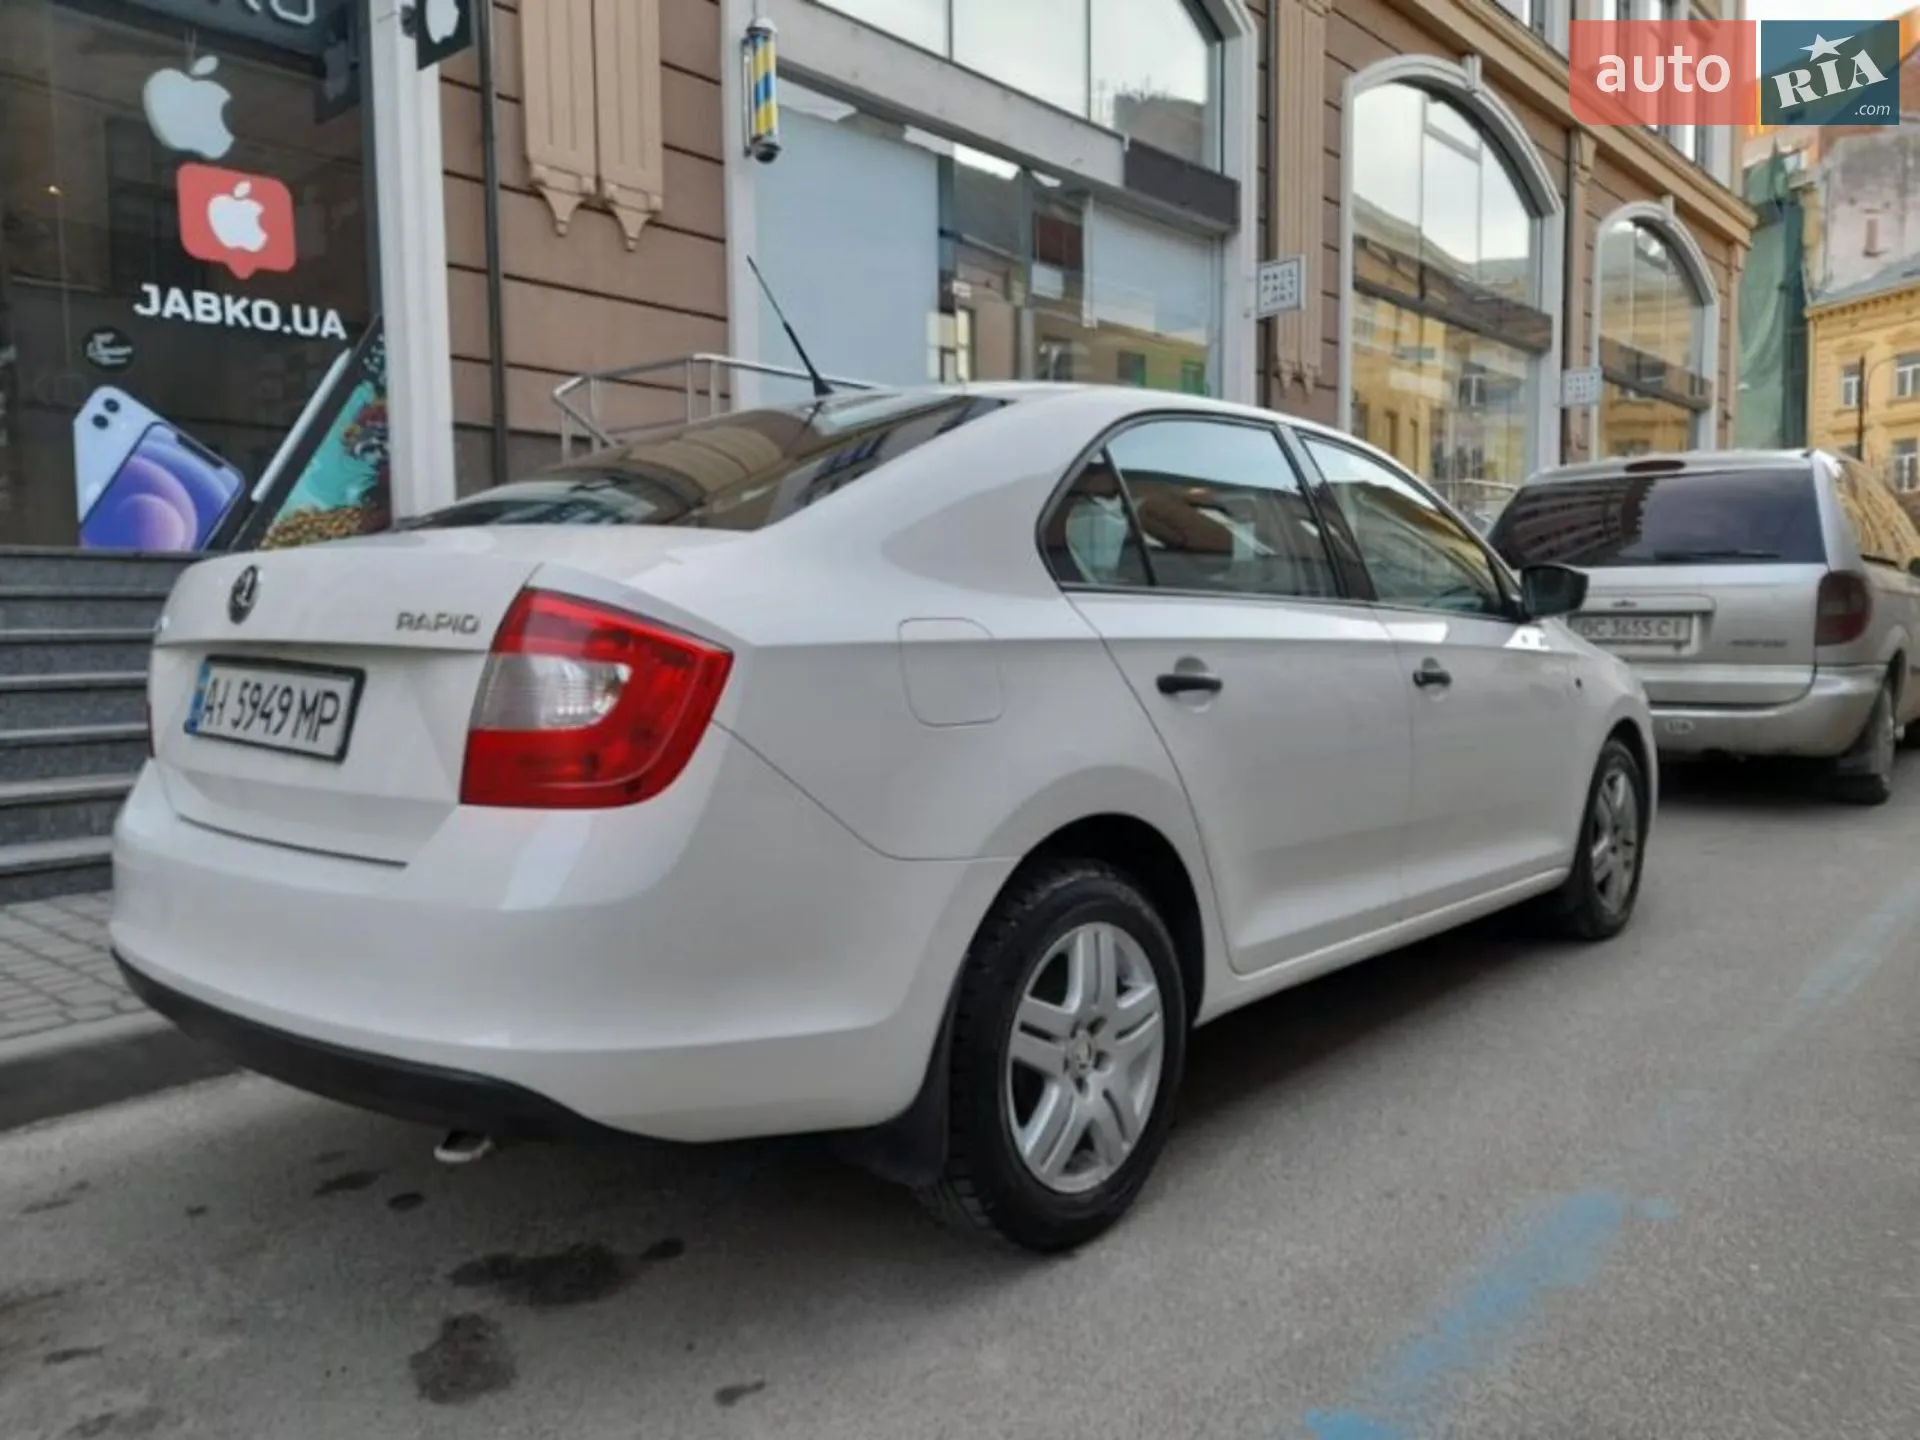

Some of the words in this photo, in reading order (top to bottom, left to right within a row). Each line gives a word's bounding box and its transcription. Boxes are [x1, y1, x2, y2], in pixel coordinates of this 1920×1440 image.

[133, 284, 347, 341] JABKO.UA
[395, 611, 481, 636] RAPID
[203, 676, 232, 727] AI
[231, 680, 294, 736] 5949
[291, 687, 341, 743] MP
